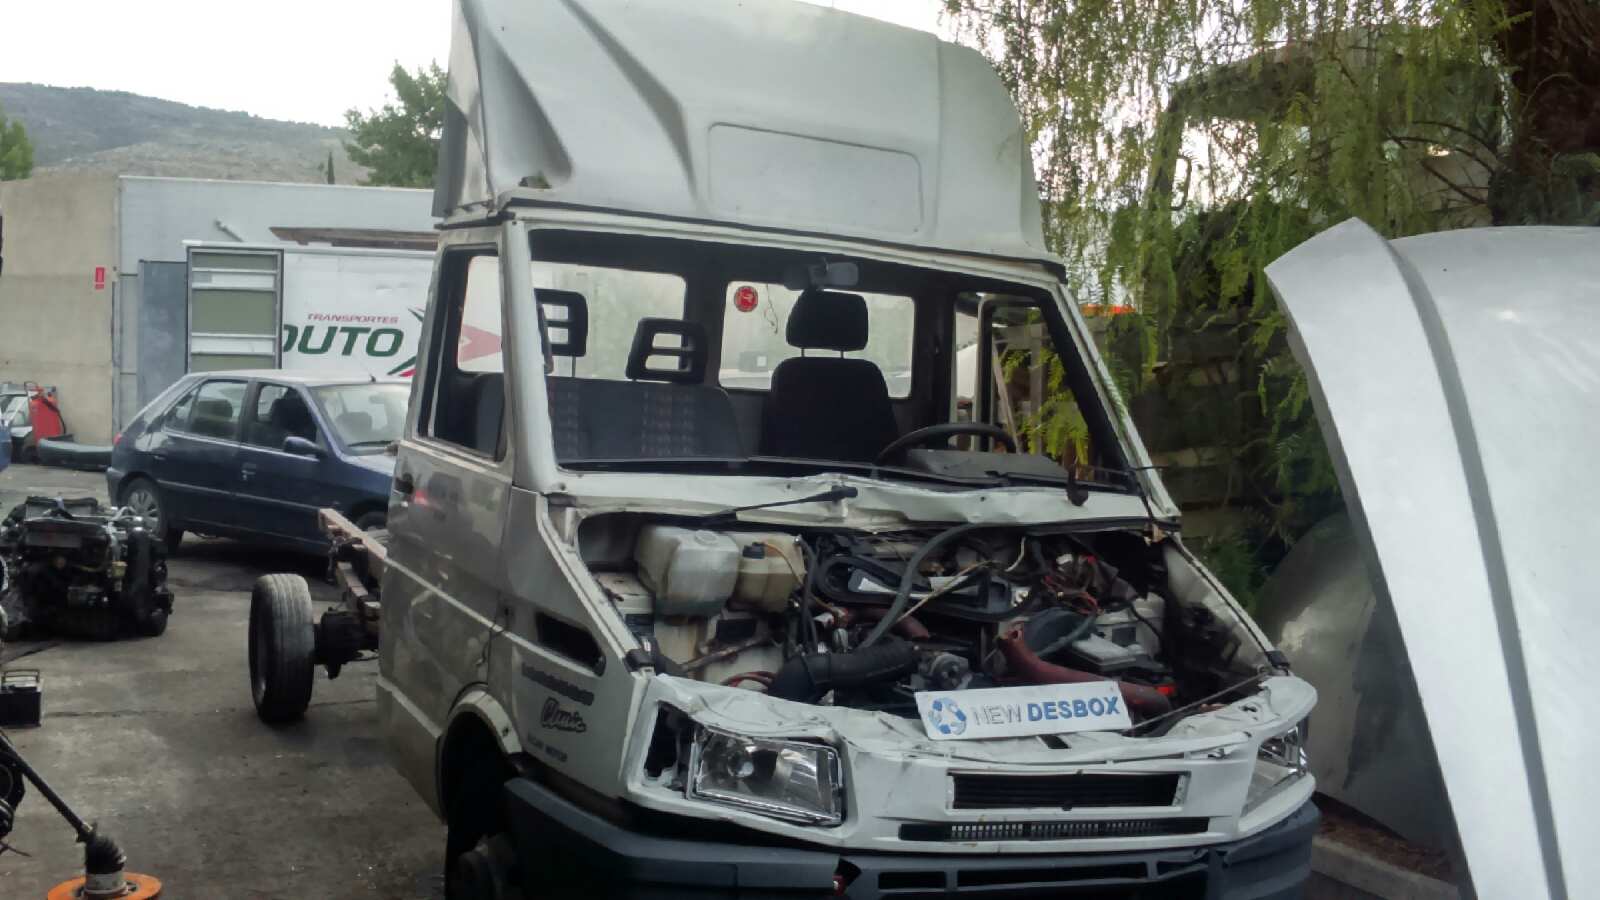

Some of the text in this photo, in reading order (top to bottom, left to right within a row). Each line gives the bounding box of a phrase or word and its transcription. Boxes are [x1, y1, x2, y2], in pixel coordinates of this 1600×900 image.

[307, 313, 399, 324] TRANSPORTES
[971, 697, 1121, 725] NEW DESBOX
